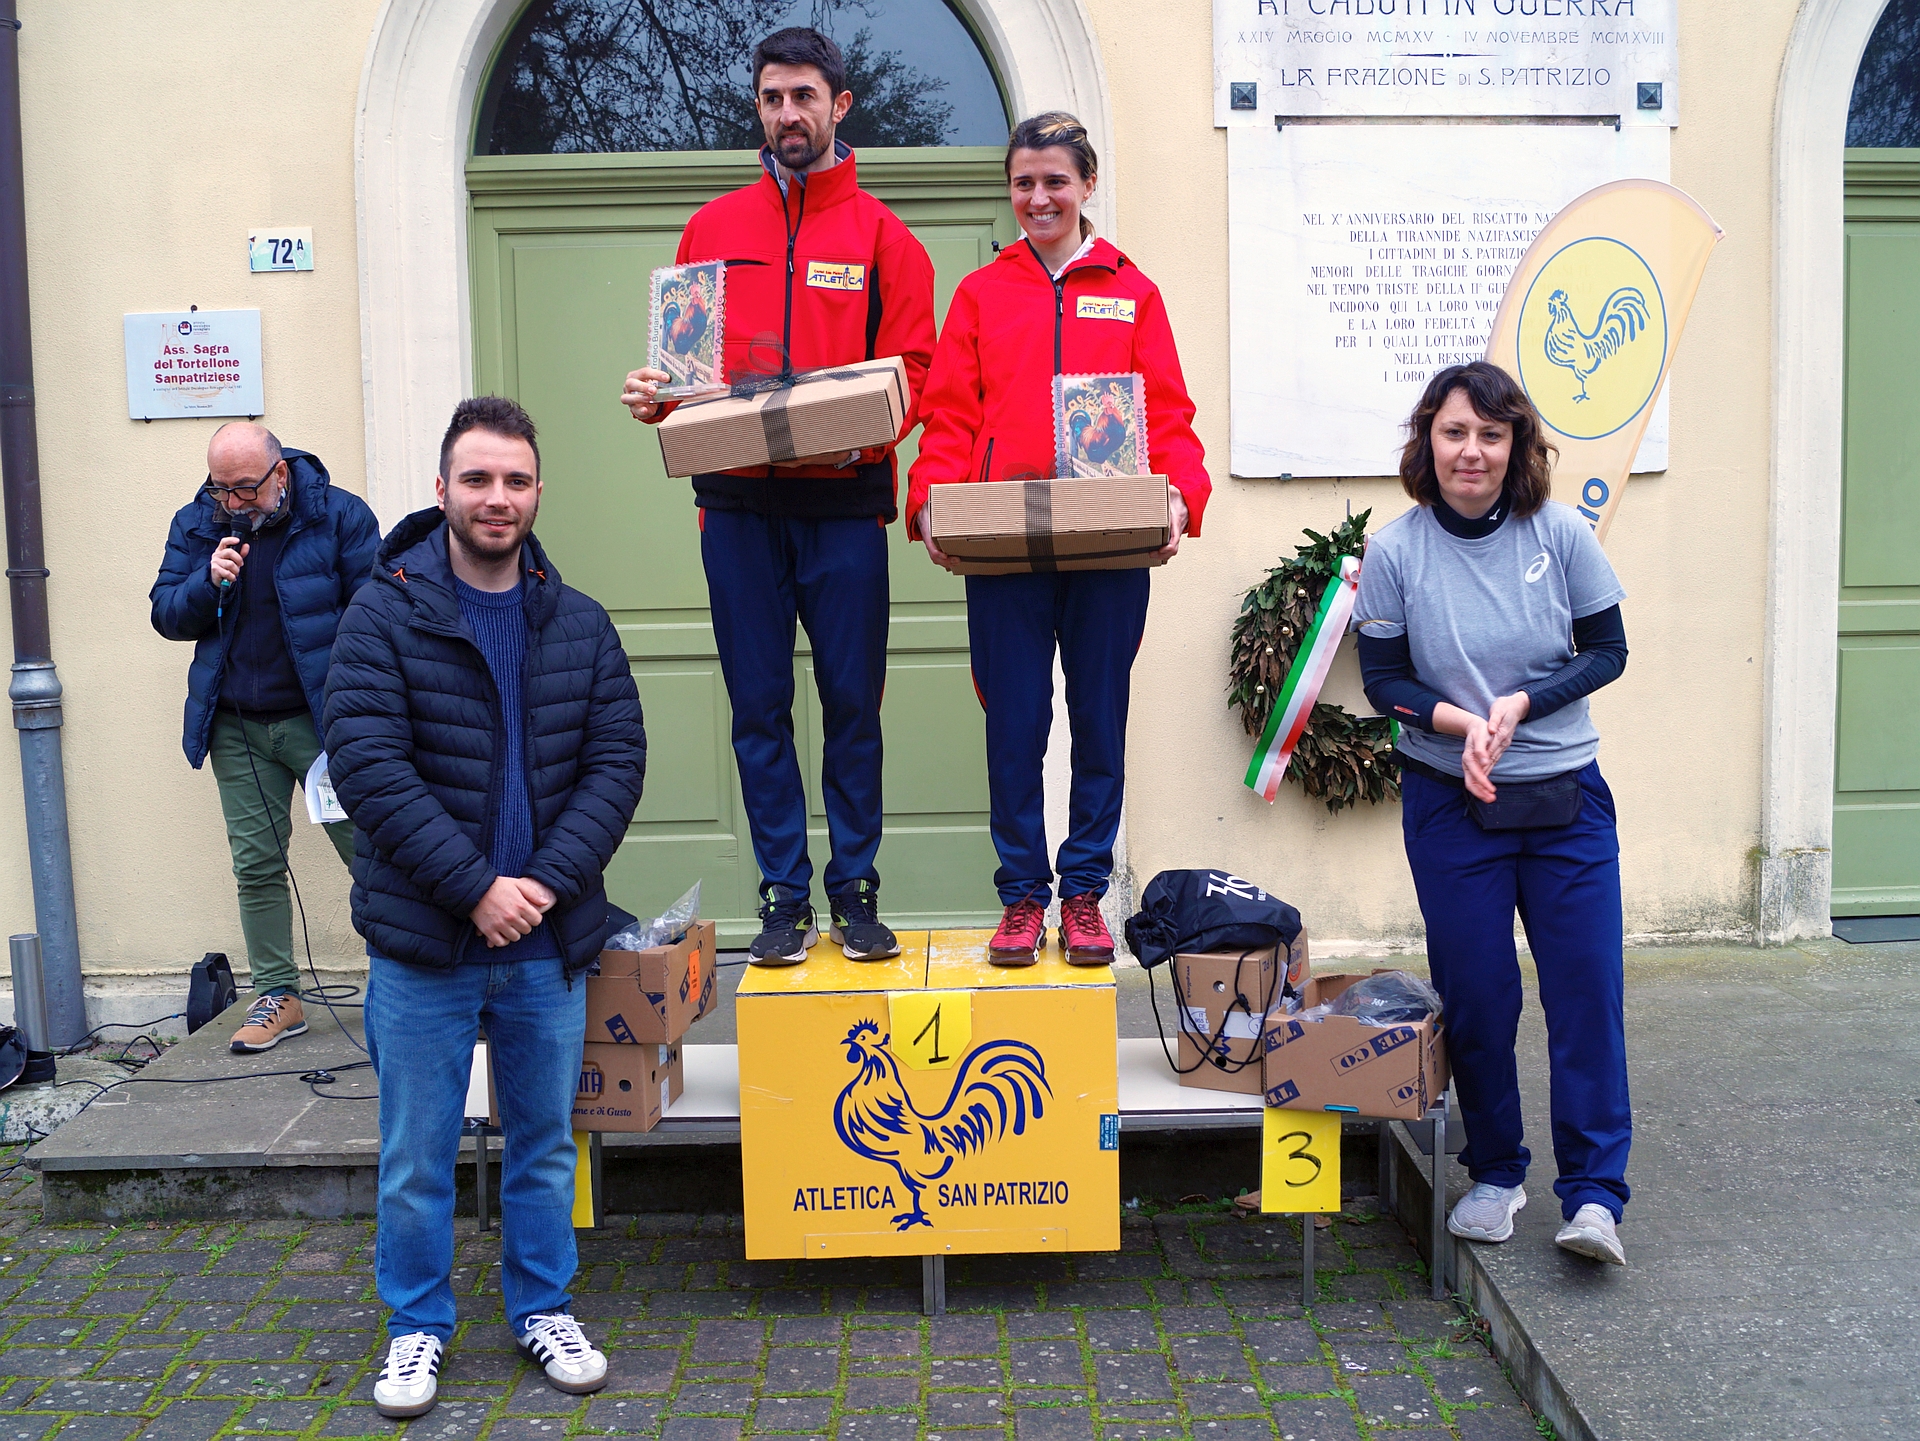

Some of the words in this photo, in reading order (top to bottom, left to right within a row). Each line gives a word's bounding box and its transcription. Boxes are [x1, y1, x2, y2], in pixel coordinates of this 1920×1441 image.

[1237, 30, 1275, 44] XXIV
[1366, 30, 1434, 43] MCMXV
[1464, 31, 1478, 43] IV
[1486, 31, 1580, 44] NOVEMBRE
[1590, 31, 1665, 44] MCMXVIII
[1281, 68, 1316, 86] LA
[1327, 68, 1448, 86] FRAZIONE
[1458, 73, 1471, 86] DI
[1302, 213, 1325, 225] NEL
[1346, 212, 1435, 225] ANNIVERSARIO
[1442, 212, 1465, 224] DEL
[1473, 212, 1528, 224] RISCATTO
[1349, 230, 1388, 242] DELLA
[1396, 230, 1461, 242] TIRANNIDE
[1369, 248, 1373, 260] I
[1378, 248, 1436, 260] CITTADINI
[1443, 248, 1455, 259] DI
[1310, 265, 1353, 278] MEMORI
[1365, 265, 1402, 277] DELLE
[1412, 264, 1468, 277] TRAGICHE
[1307, 283, 1327, 296] NEL
[1332, 283, 1370, 296] TEMPO
[1376, 283, 1419, 295] TRISTE
[1427, 282, 1465, 295] DELLA
[1329, 301, 1380, 313] INCIDONO
[1389, 301, 1407, 314] QUI
[1417, 301, 1432, 313] LA
[1439, 300, 1468, 312] LORO
[1348, 318, 1355, 330] E
[1361, 318, 1377, 330] LA
[1386, 318, 1415, 330] LORO
[1335, 335, 1357, 348] PER
[1368, 335, 1372, 348] I
[1383, 335, 1418, 349] QUALI
[163, 344, 189, 356] Ass.
[193, 344, 230, 357] Sagra
[154, 359, 173, 370] del
[176, 357, 240, 369] Tortellone
[1394, 352, 1432, 365] NELLA
[155, 371, 240, 385] Sanpatriziese
[1396, 370, 1425, 383] LORO
[913, 1002, 950, 1064] 1
[1378, 1027, 1410, 1051] TE
[1340, 1048, 1369, 1068] CO
[607, 1107, 632, 1117] Gusto
[1278, 1131, 1322, 1188] 3
[793, 1185, 897, 1212] ATLETICA
[938, 1183, 978, 1208] SAN
[983, 1180, 1069, 1207] PATRIZIO
